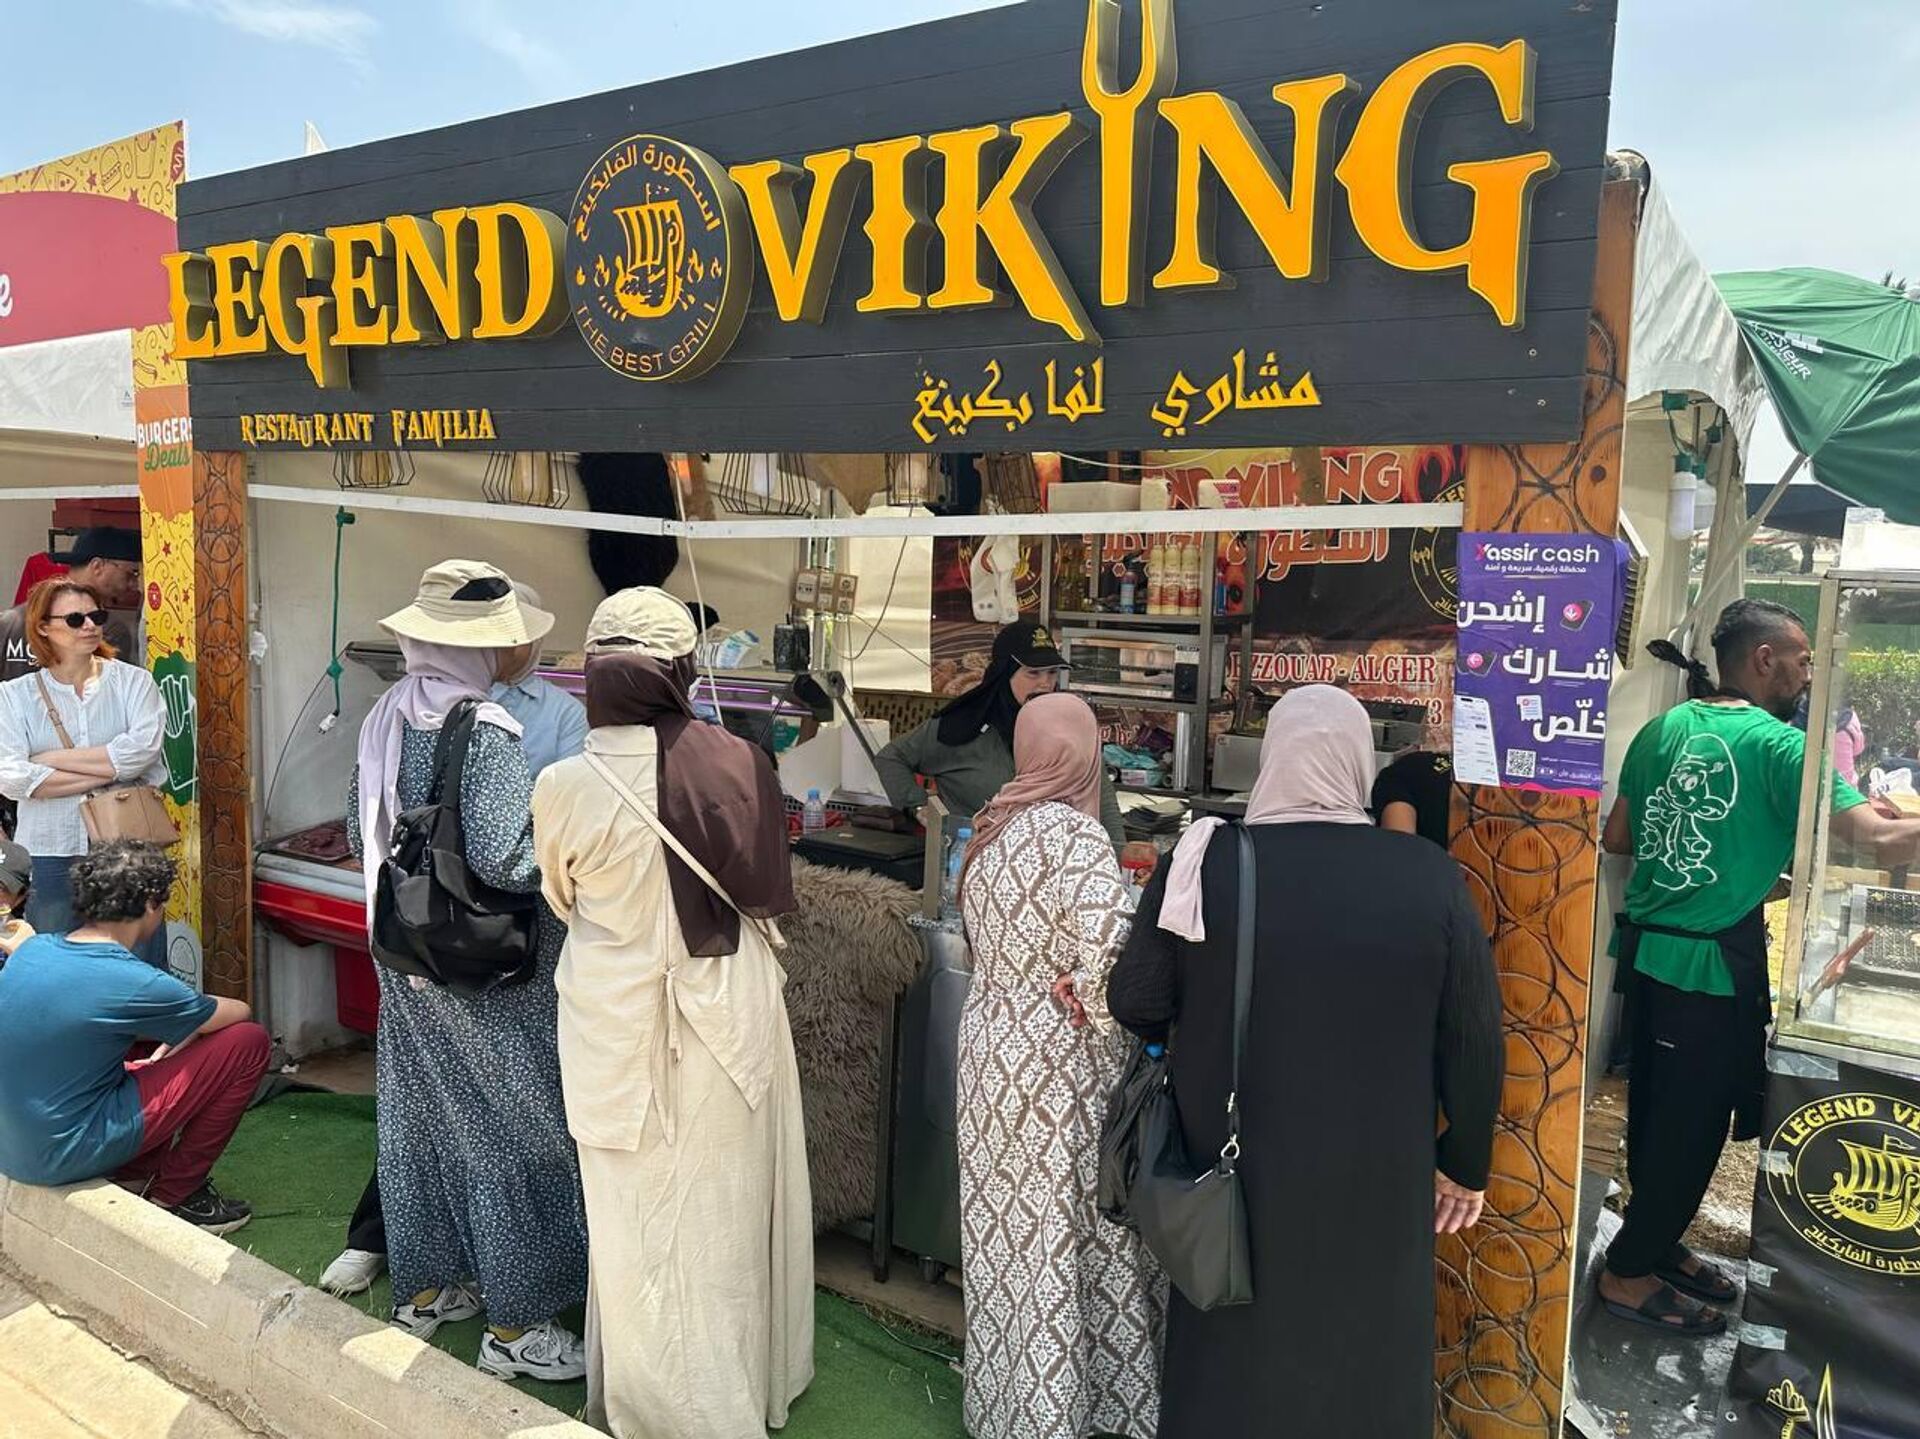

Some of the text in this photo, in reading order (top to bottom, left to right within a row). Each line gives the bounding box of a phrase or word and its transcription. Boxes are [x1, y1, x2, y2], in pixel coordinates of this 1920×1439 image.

[161, 0, 1551, 388] LEGEND VIKING
[576, 297, 720, 374] THE BEST GRILL
[1150, 347, 1322, 439] مشاوي
[240, 407, 498, 448] RESTAURANT FAMILIA
[1476, 542, 1600, 563] Yassir cash
[1455, 590, 1546, 633] إشحن
[1348, 653, 1438, 685] ALGER
[1502, 646, 1610, 684] شارك
[1781, 1097, 1876, 1146] LEGEND
